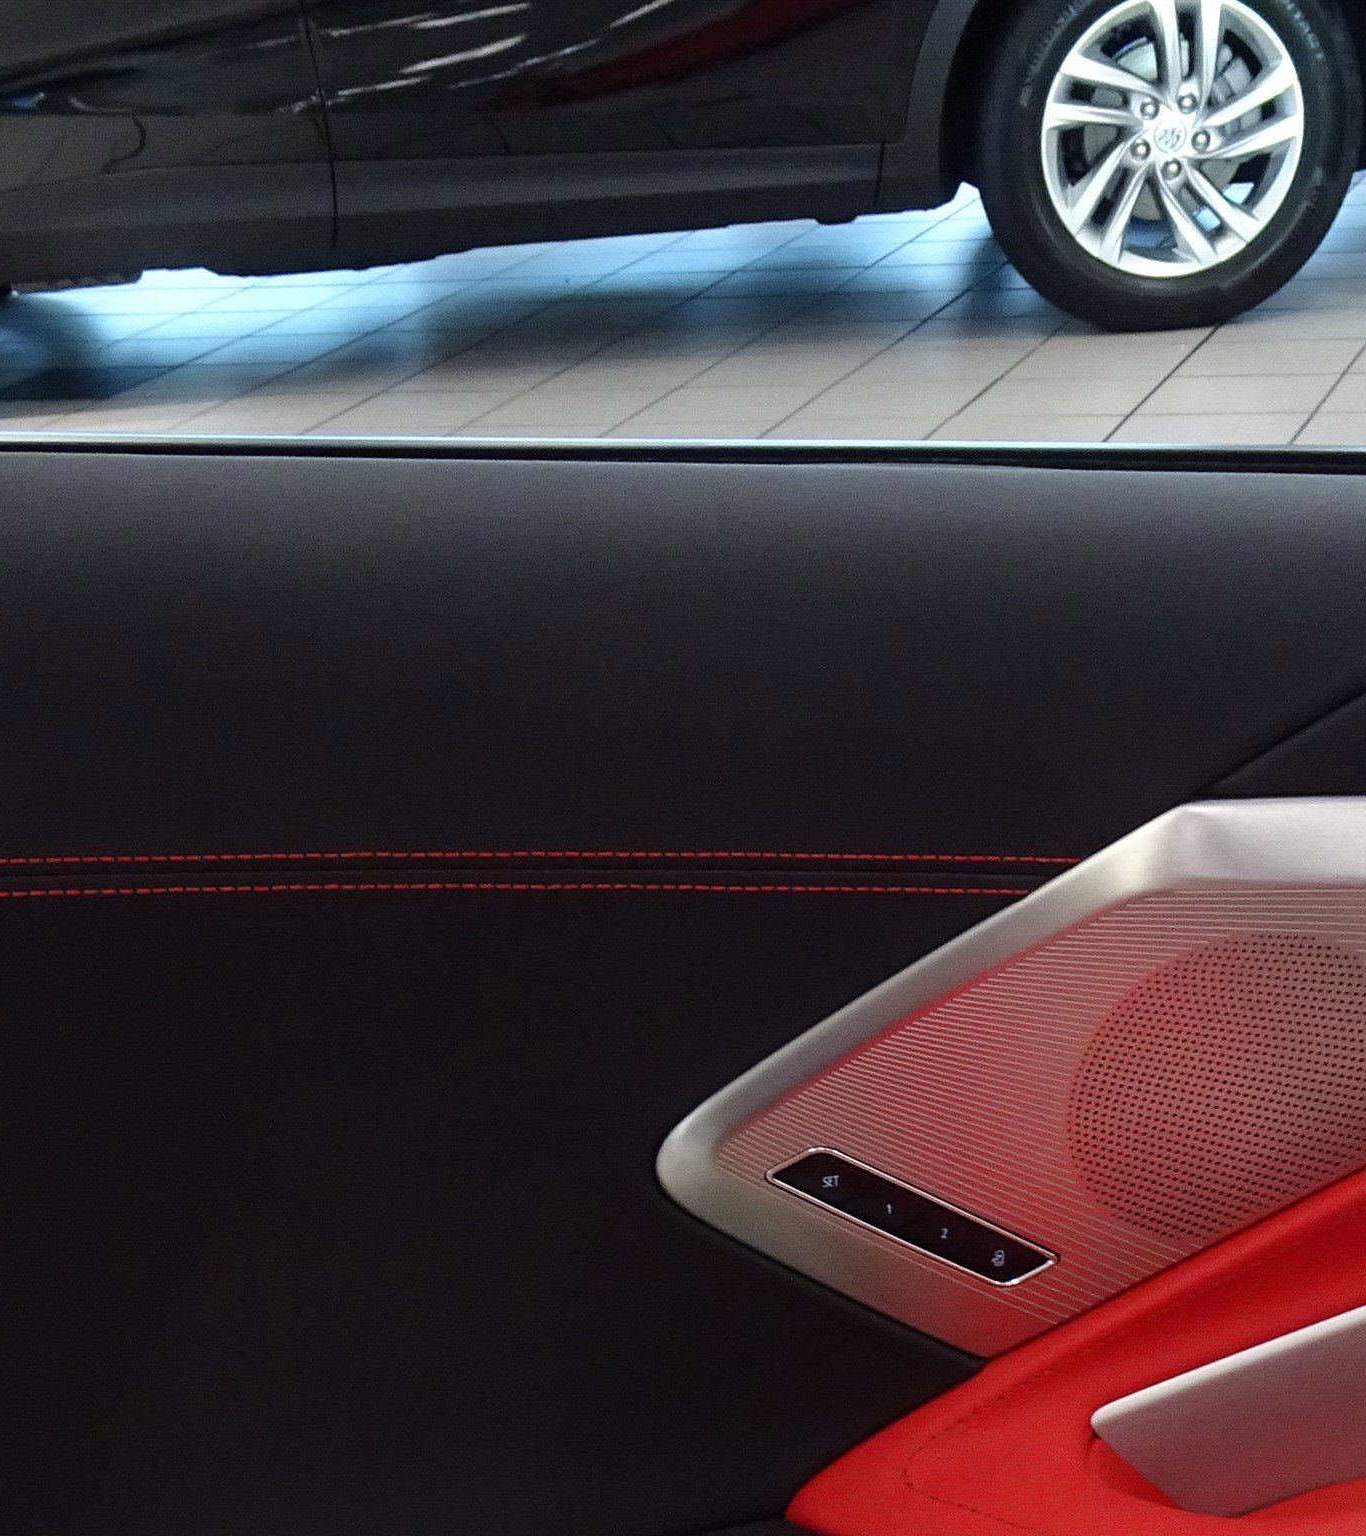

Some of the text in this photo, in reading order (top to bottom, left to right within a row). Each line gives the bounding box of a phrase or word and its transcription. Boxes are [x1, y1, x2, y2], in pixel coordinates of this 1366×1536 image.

[821, 1174, 840, 1188] SET
[885, 1203, 893, 1215] 1
[940, 1227, 949, 1240] 2
